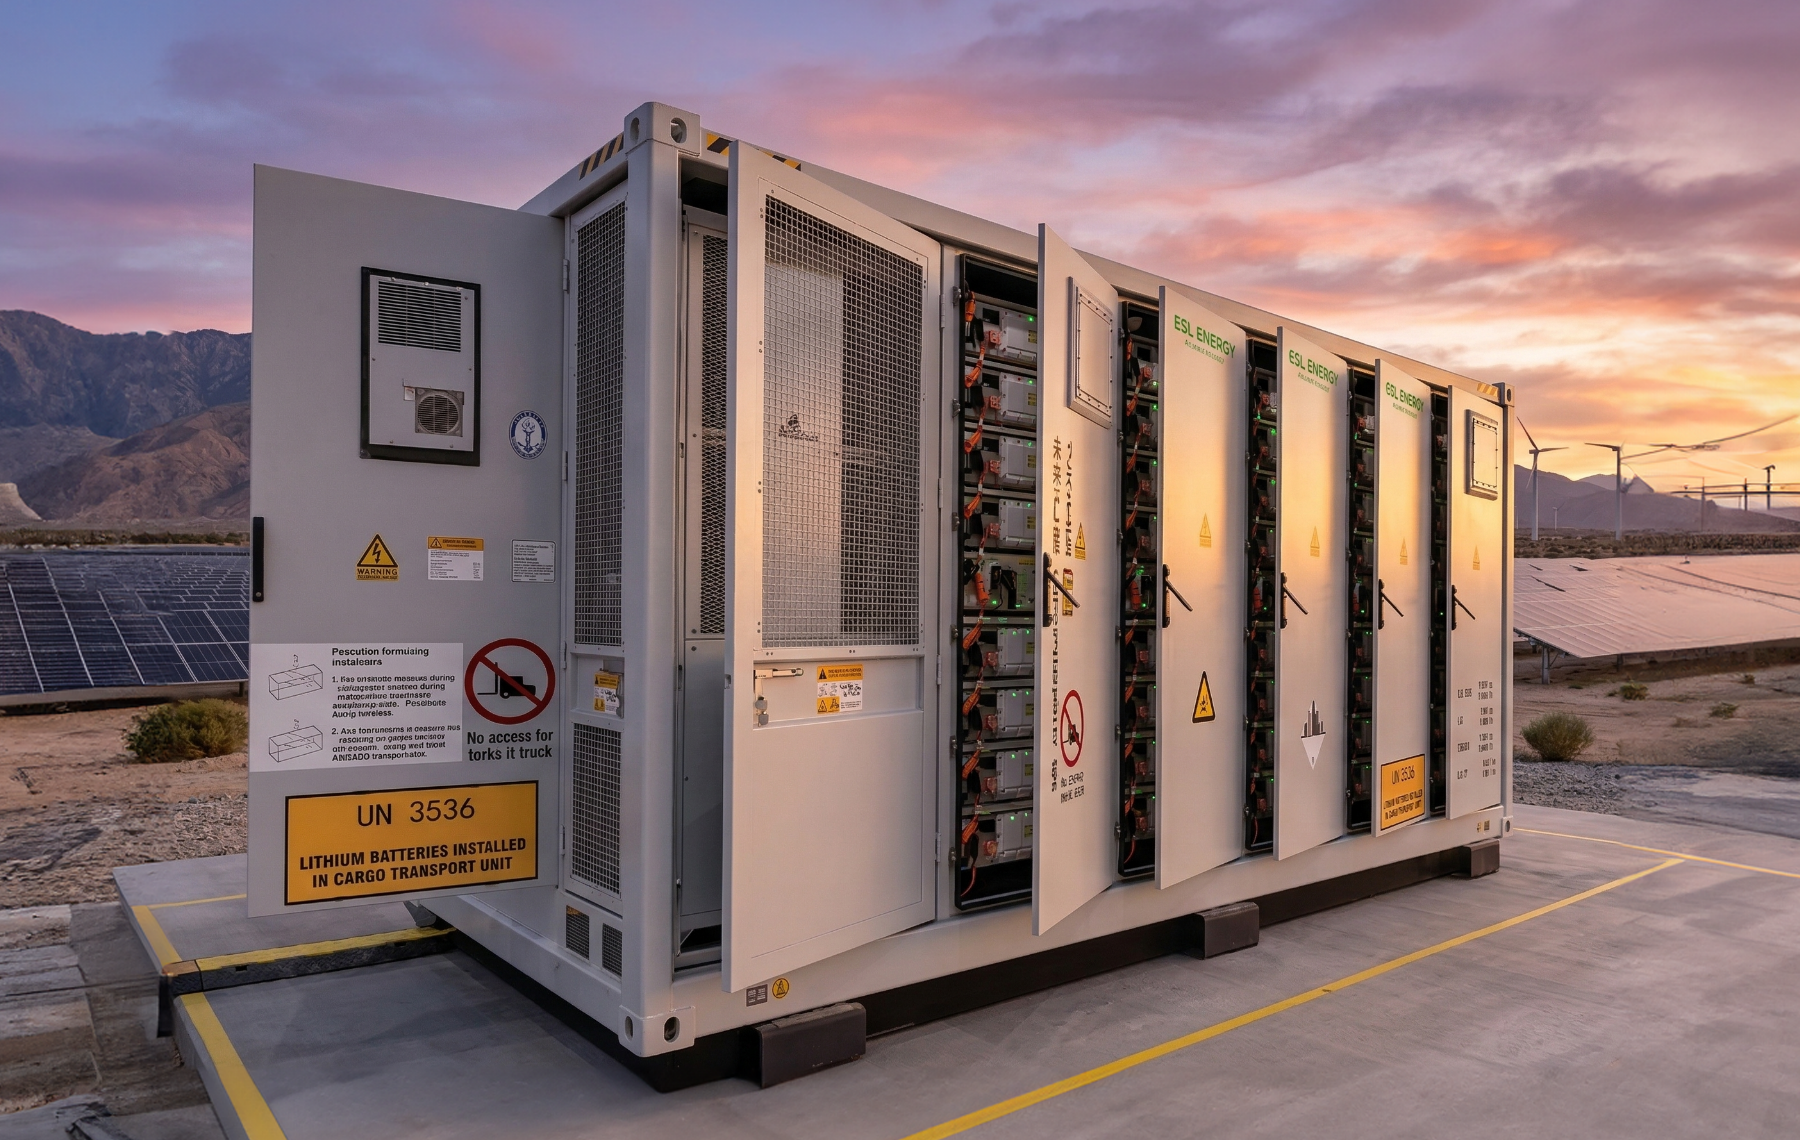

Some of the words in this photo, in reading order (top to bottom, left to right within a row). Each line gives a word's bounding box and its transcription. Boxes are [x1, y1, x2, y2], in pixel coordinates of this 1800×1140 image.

[1174, 314, 1194, 338] ESL
[1196, 326, 1236, 359] ENERGY
[1289, 349, 1306, 370] ESL
[1307, 358, 1339, 387] ENERGY
[1399, 389, 1424, 412] ENERGY
[332, 648, 379, 656] Pescution
[420, 683, 445, 691] during
[430, 674, 455, 682] during
[467, 731, 484, 744] No
[488, 731, 532, 743] access
[535, 728, 554, 742] for
[468, 747, 502, 761] torks
[506, 746, 516, 760] it
[519, 745, 553, 759] truck
[357, 803, 392, 826] UN
[409, 797, 476, 823] 3536
[299, 851, 365, 870] LITHIUM
[370, 844, 448, 864] BATTERIES
[453, 837, 527, 857] INSTALLED
[312, 874, 328, 888] IN
[333, 869, 386, 886] CARGO
[390, 859, 476, 881] TRANSPORT
[480, 856, 513, 872] UNIT
